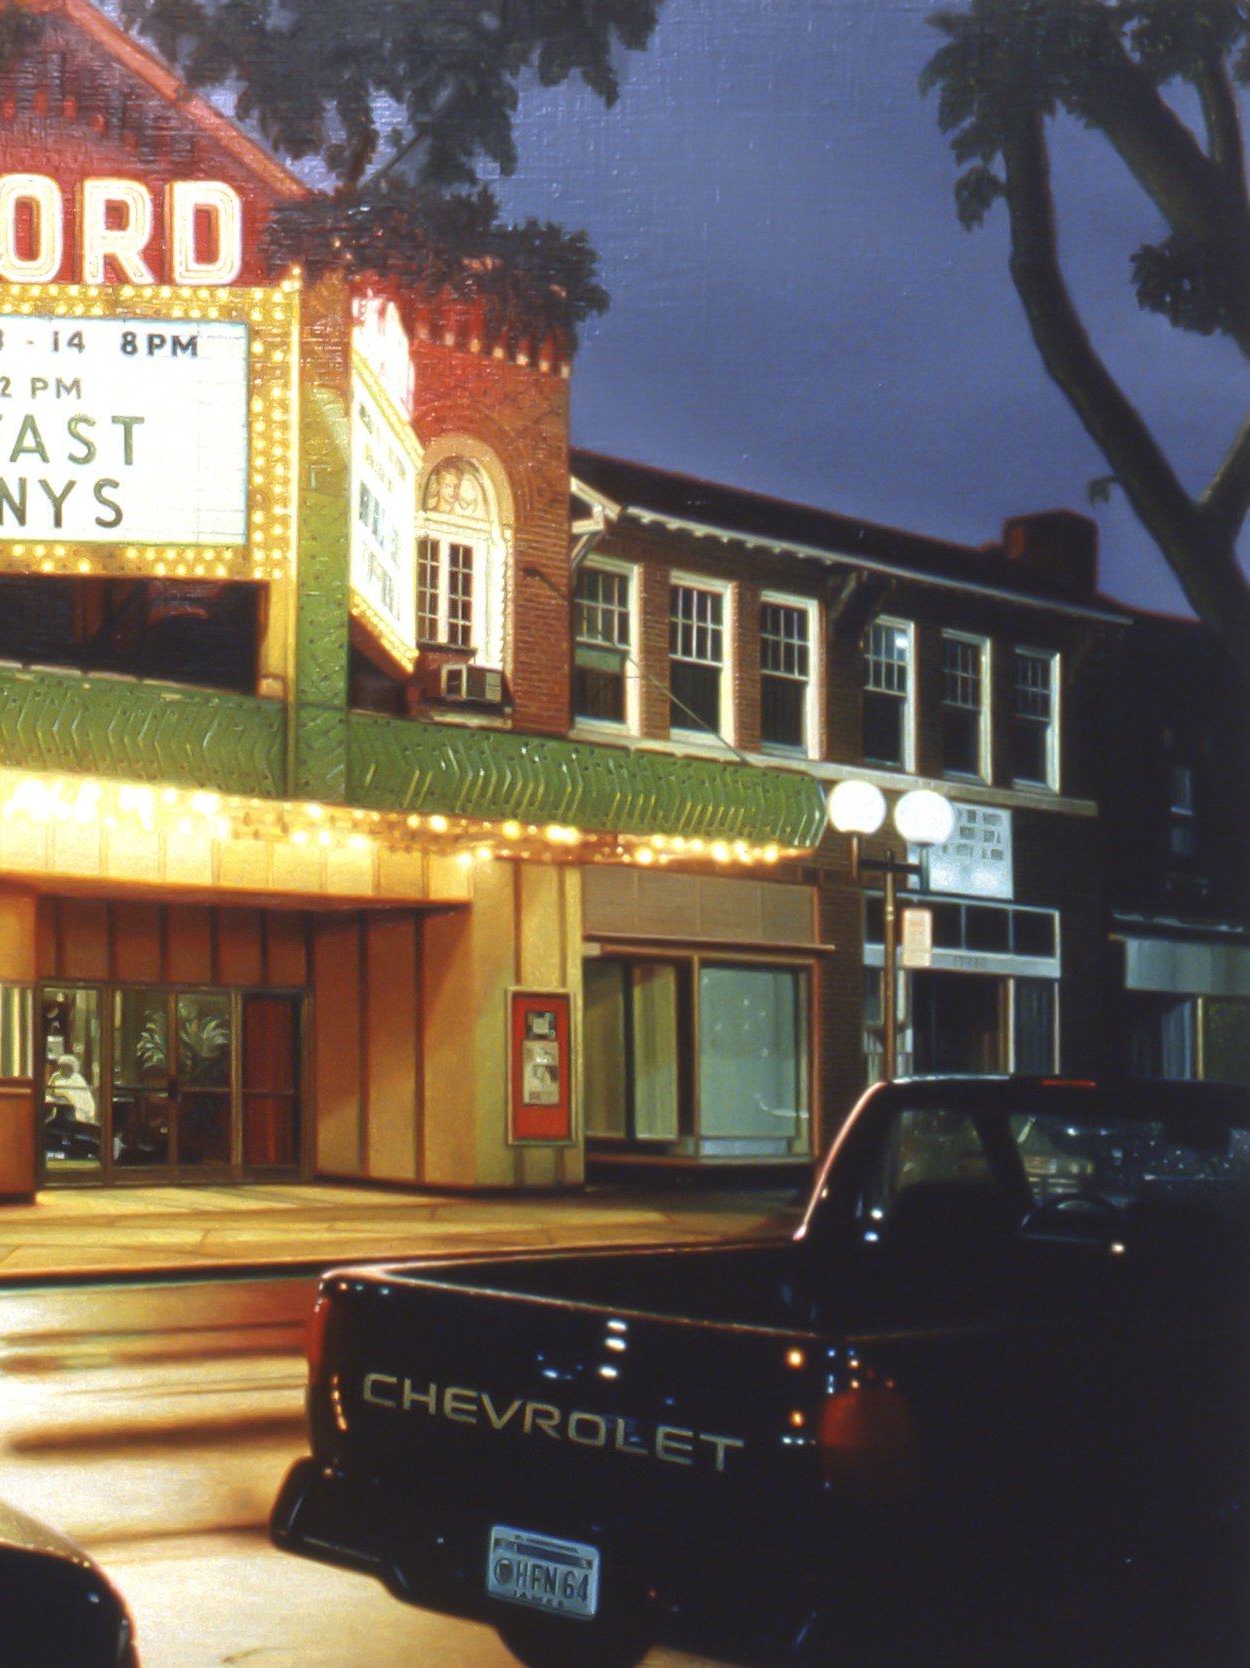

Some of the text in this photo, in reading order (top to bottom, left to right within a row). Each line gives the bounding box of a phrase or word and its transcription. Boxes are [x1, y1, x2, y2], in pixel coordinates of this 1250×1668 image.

[52, 330, 87, 353] 14
[30, 376, 82, 400] PM
[363, 1372, 745, 1472] CHEVROLET
